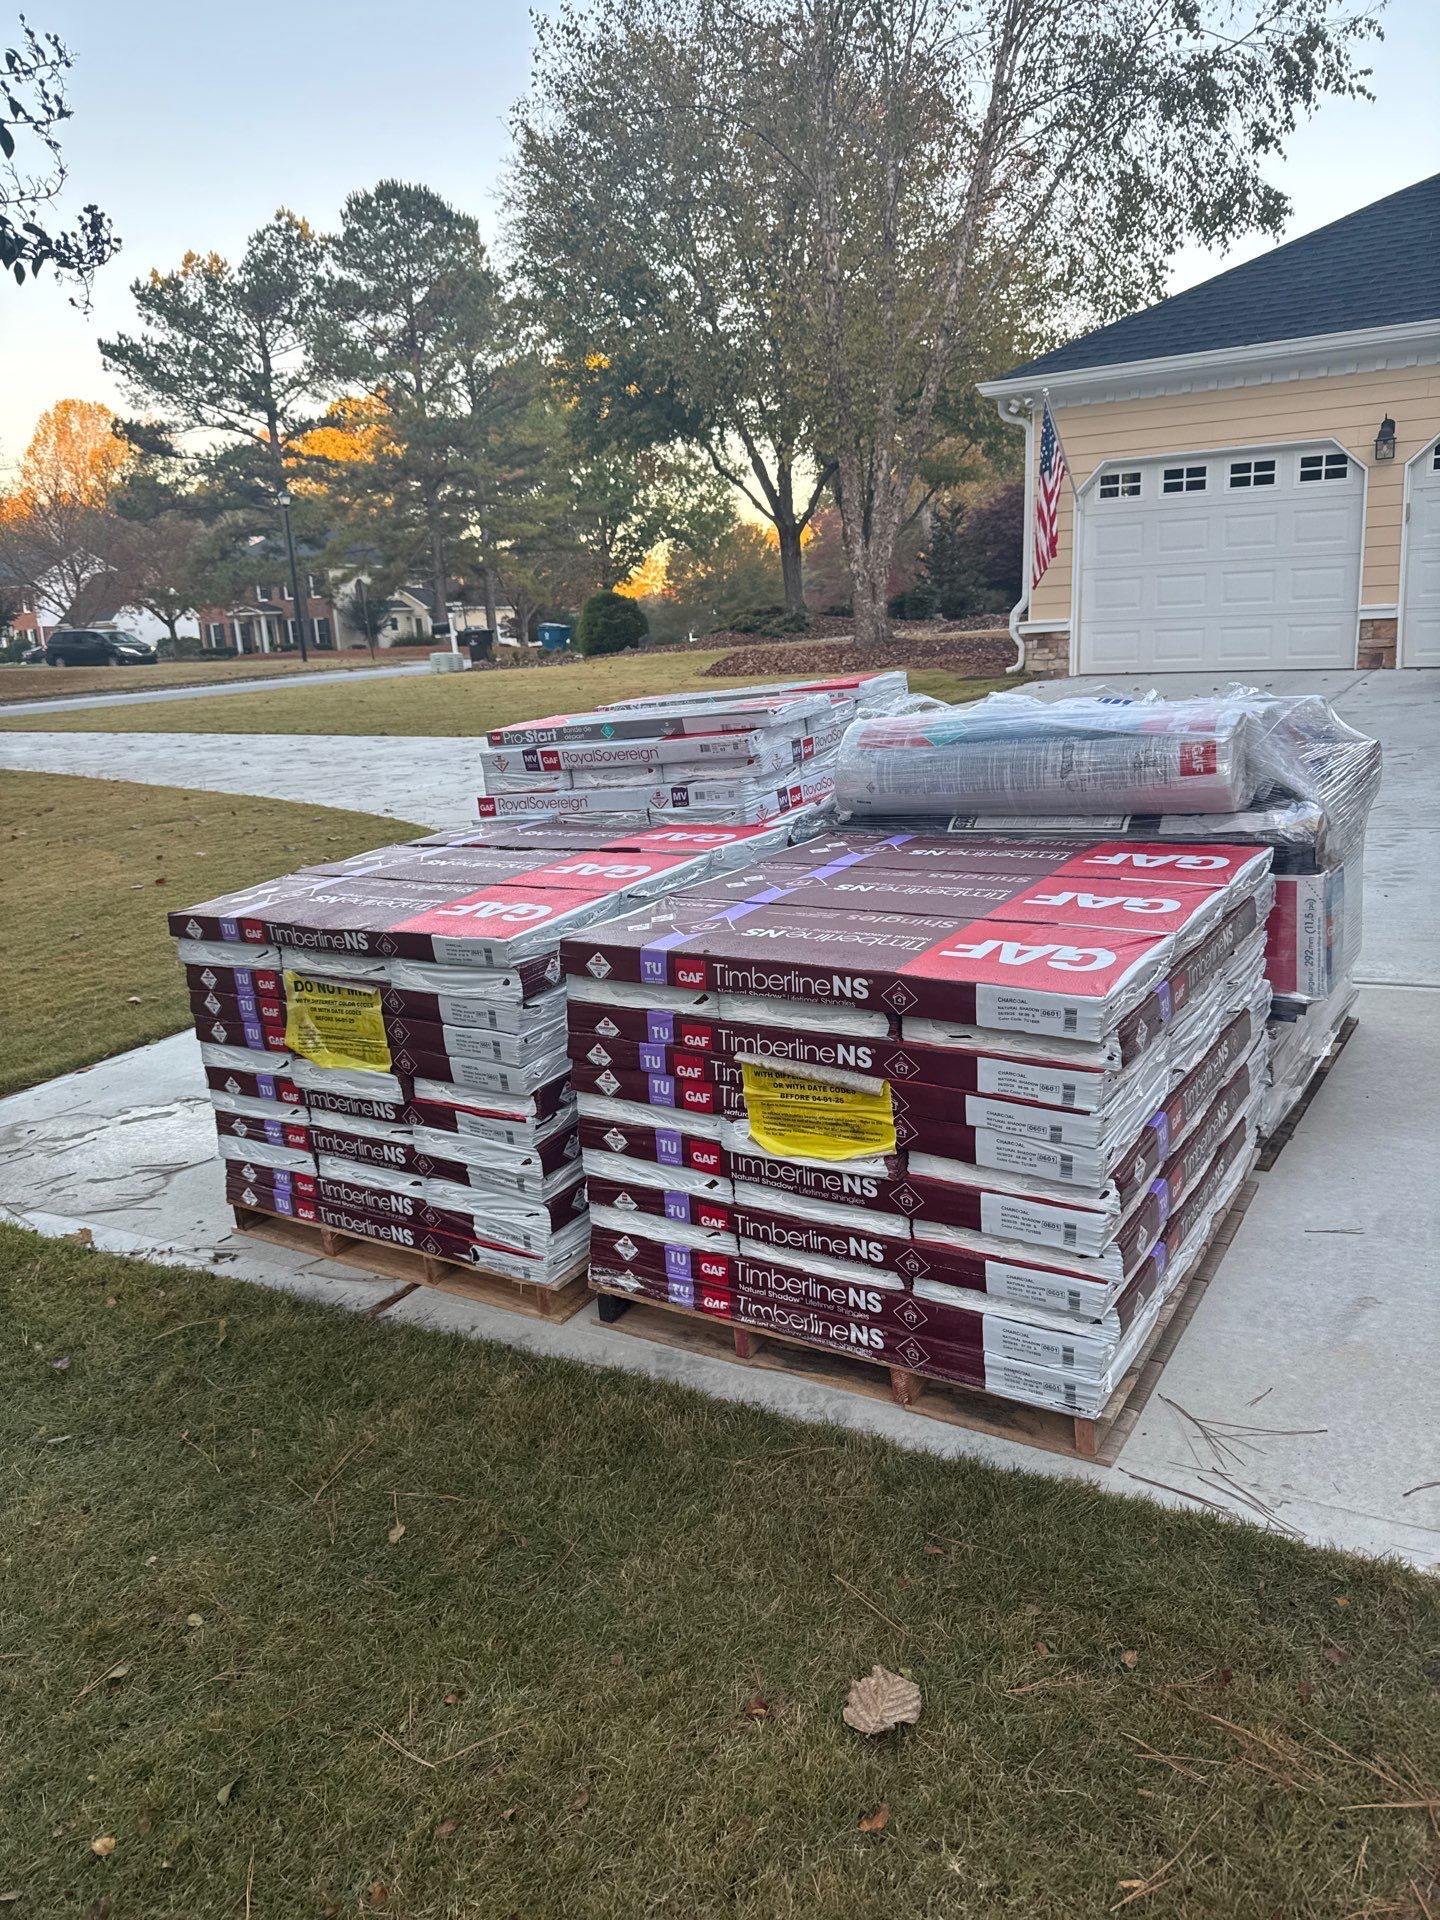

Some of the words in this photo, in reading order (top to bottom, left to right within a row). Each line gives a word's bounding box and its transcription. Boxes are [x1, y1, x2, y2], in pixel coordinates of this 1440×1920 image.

[503, 730, 558, 744] Pro-Start
[525, 754, 537, 763] MV
[543, 756, 558, 765] GAF
[562, 747, 659, 765] RoyalSovereign
[1193, 744, 1204, 773] GAF
[673, 790, 687, 801] MV
[778, 797, 788, 806] MV
[791, 794, 801, 804] GAF
[480, 804, 494, 812] GAF
[498, 796, 589, 812] RoyalSovereign
[633, 832, 737, 843] GAF
[1082, 852, 1230, 870] GAF
[541, 862, 652, 879] GAF
[927, 871, 1032, 884] Shingles
[834, 883, 1010, 901] TimberlineNS
[1022, 891, 1182, 914] GAF
[433, 901, 553, 922] GAF
[846, 913, 958, 930] Shingles
[223, 923, 235, 935] TU
[245, 928, 263, 940] GAF
[265, 923, 369, 950] TimberlineNS
[741, 928, 928, 951] TimberlineNS
[939, 939, 1117, 973] GAF
[644, 961, 662, 975] TU
[236, 973, 248, 984] TU
[678, 970, 703, 983] GAF
[712, 963, 869, 999] TimberlineNS
[258, 980, 276, 990] GAF
[294, 980, 313, 992] DO
[241, 999, 253, 1011] TU
[820, 997, 855, 1008] Shingles
[997, 996, 1028, 1005] CHARCOAL
[262, 1006, 280, 1018] GAF
[247, 1028, 259, 1040] TU
[651, 1026, 669, 1040] TU
[268, 1035, 285, 1046] GAF
[684, 1034, 709, 1047] GAF
[717, 1029, 873, 1068] TimberlineNS
[643, 1054, 661, 1069] TU
[676, 1065, 702, 1079] GAF
[754, 1070, 774, 1078] WITH
[997, 1070, 1027, 1079] CHARCOAL
[261, 1084, 273, 1096] TU
[652, 1079, 669, 1095] TU
[784, 1083, 806, 1091] WITH
[829, 1086, 857, 1095] CODES
[282, 1091, 299, 1102] GAF
[685, 1090, 710, 1104] GAF
[780, 1092, 811, 1101] BEFORE
[811, 1095, 845, 1104] 04-01-25
[302, 1088, 396, 1120] TimberlineNS
[986, 1110, 1015, 1119] CHARCOAL
[1028, 1125, 1046, 1133] 0601
[288, 1134, 305, 1144] GAF
[996, 1139, 1026, 1149] CHARCOAL
[309, 1129, 406, 1164] TimberlineNS
[659, 1138, 677, 1154] TU
[692, 1151, 718, 1165] GAF
[1038, 1154, 1056, 1163] 0601
[728, 1153, 878, 1198] TimberlineNS
[297, 1182, 314, 1192] GAF
[731, 1171, 760, 1183] Natural
[761, 1177, 794, 1191] Shadow
[798, 1186, 830, 1198] Lifetime
[831, 1193, 866, 1205] Shingles
[317, 1178, 414, 1216] TimberlineNS
[277, 1199, 288, 1210] TU
[298, 1208, 315, 1219] GAF
[667, 1204, 686, 1219] TU
[318, 1205, 414, 1246] TimberlineNS
[701, 1215, 726, 1228] GAF
[1043, 1222, 1060, 1230] 0601
[733, 1214, 885, 1263] TimberlineNS
[669, 1250, 687, 1266] TU
[701, 1262, 726, 1277] GAF
[734, 1261, 883, 1313] TimberlineNS
[703, 1297, 729, 1310] GAF
[739, 1283, 766, 1296] Natural
[768, 1290, 801, 1304] Shadow
[805, 1299, 835, 1311] Lifetime
[836, 1305, 870, 1321] Shingles
[736, 1295, 885, 1349] TimberlineNS
